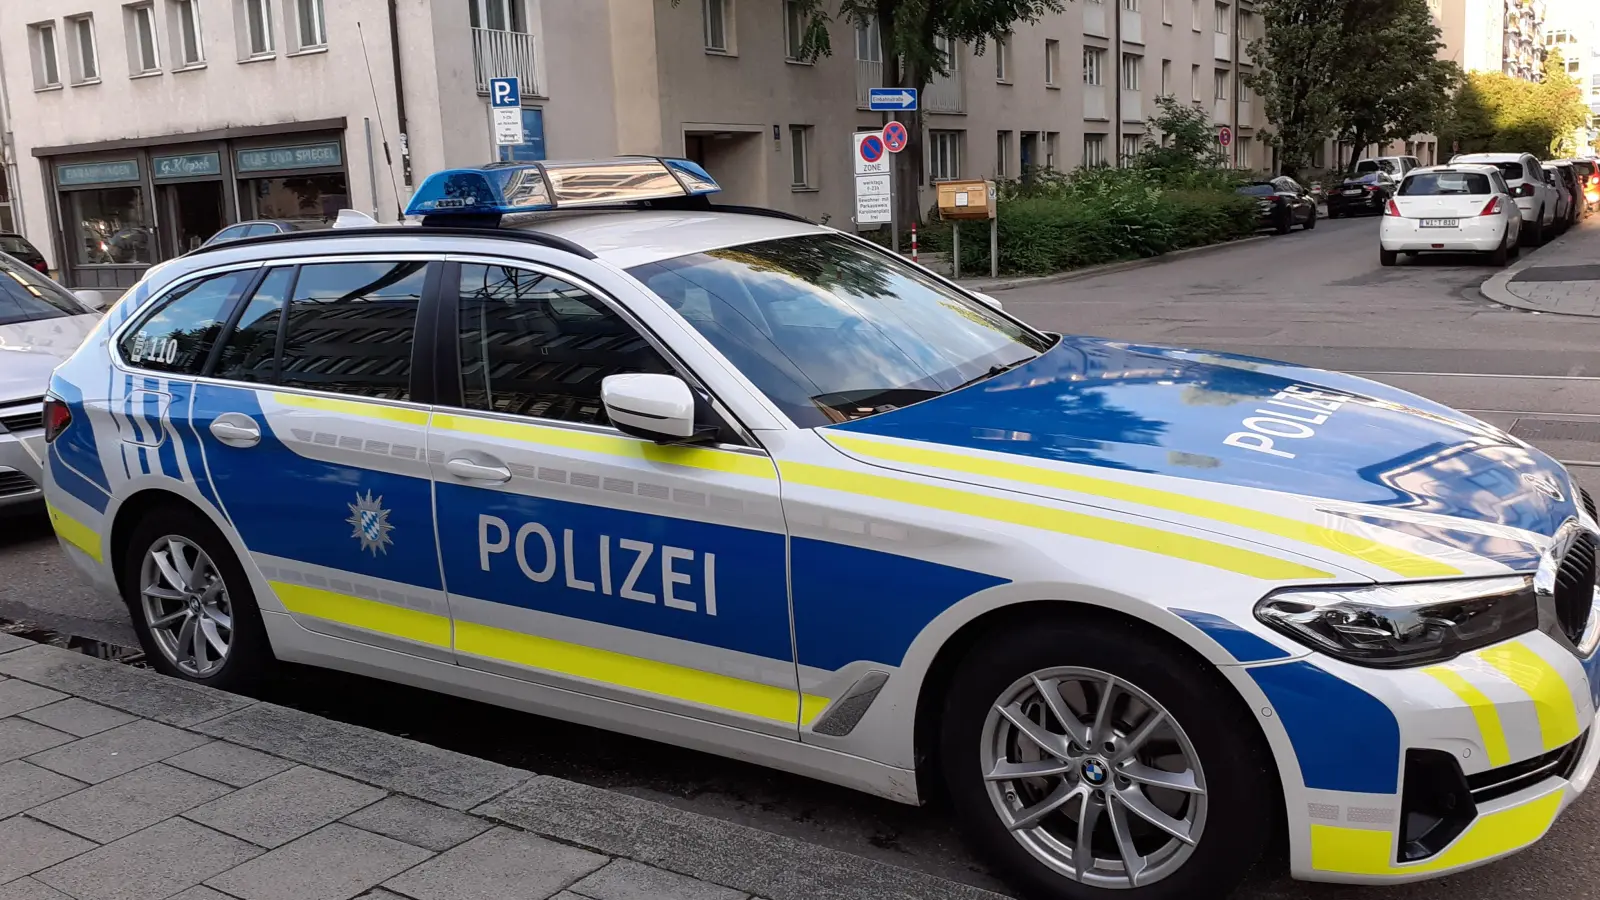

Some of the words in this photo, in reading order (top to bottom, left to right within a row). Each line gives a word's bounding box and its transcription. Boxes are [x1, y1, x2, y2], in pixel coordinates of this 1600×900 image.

[494, 81, 511, 105] P
[270, 150, 293, 163] UND
[295, 146, 334, 161] SPIEGEL
[863, 163, 882, 172] ZONE
[147, 337, 178, 364] 110
[1222, 383, 1355, 459] POLIZEI
[478, 513, 717, 616] POLIZEI
